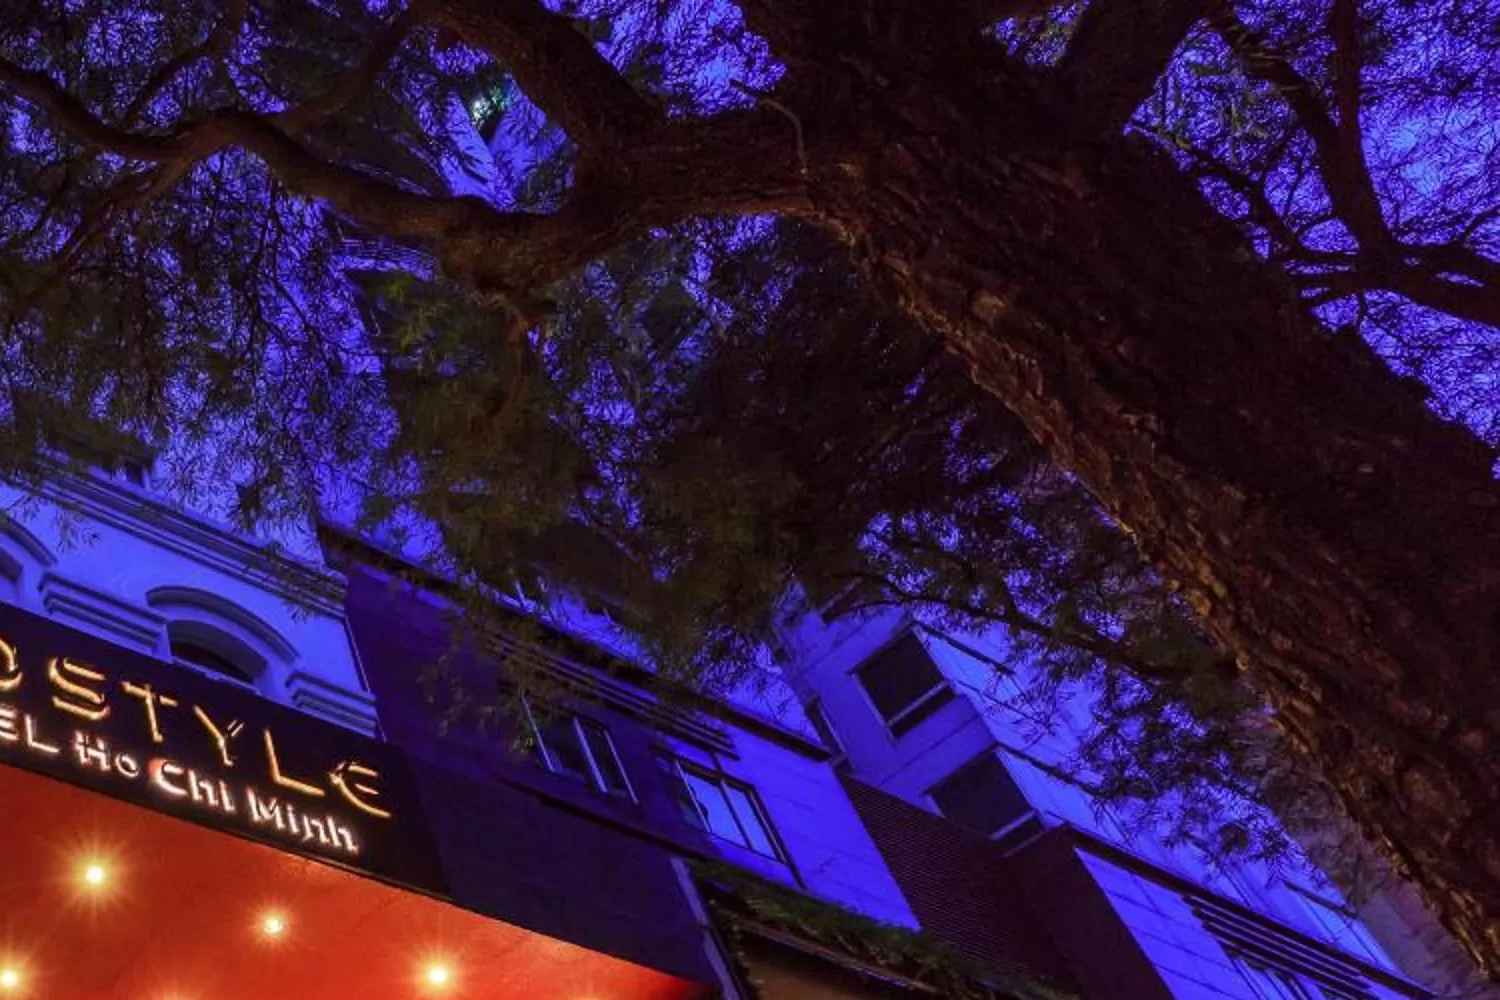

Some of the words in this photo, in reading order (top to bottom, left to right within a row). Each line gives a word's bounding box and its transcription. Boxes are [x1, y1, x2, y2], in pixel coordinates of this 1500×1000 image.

[74, 731, 140, 777] Ho
[148, 757, 236, 812] Chi
[247, 786, 360, 855] Minh
